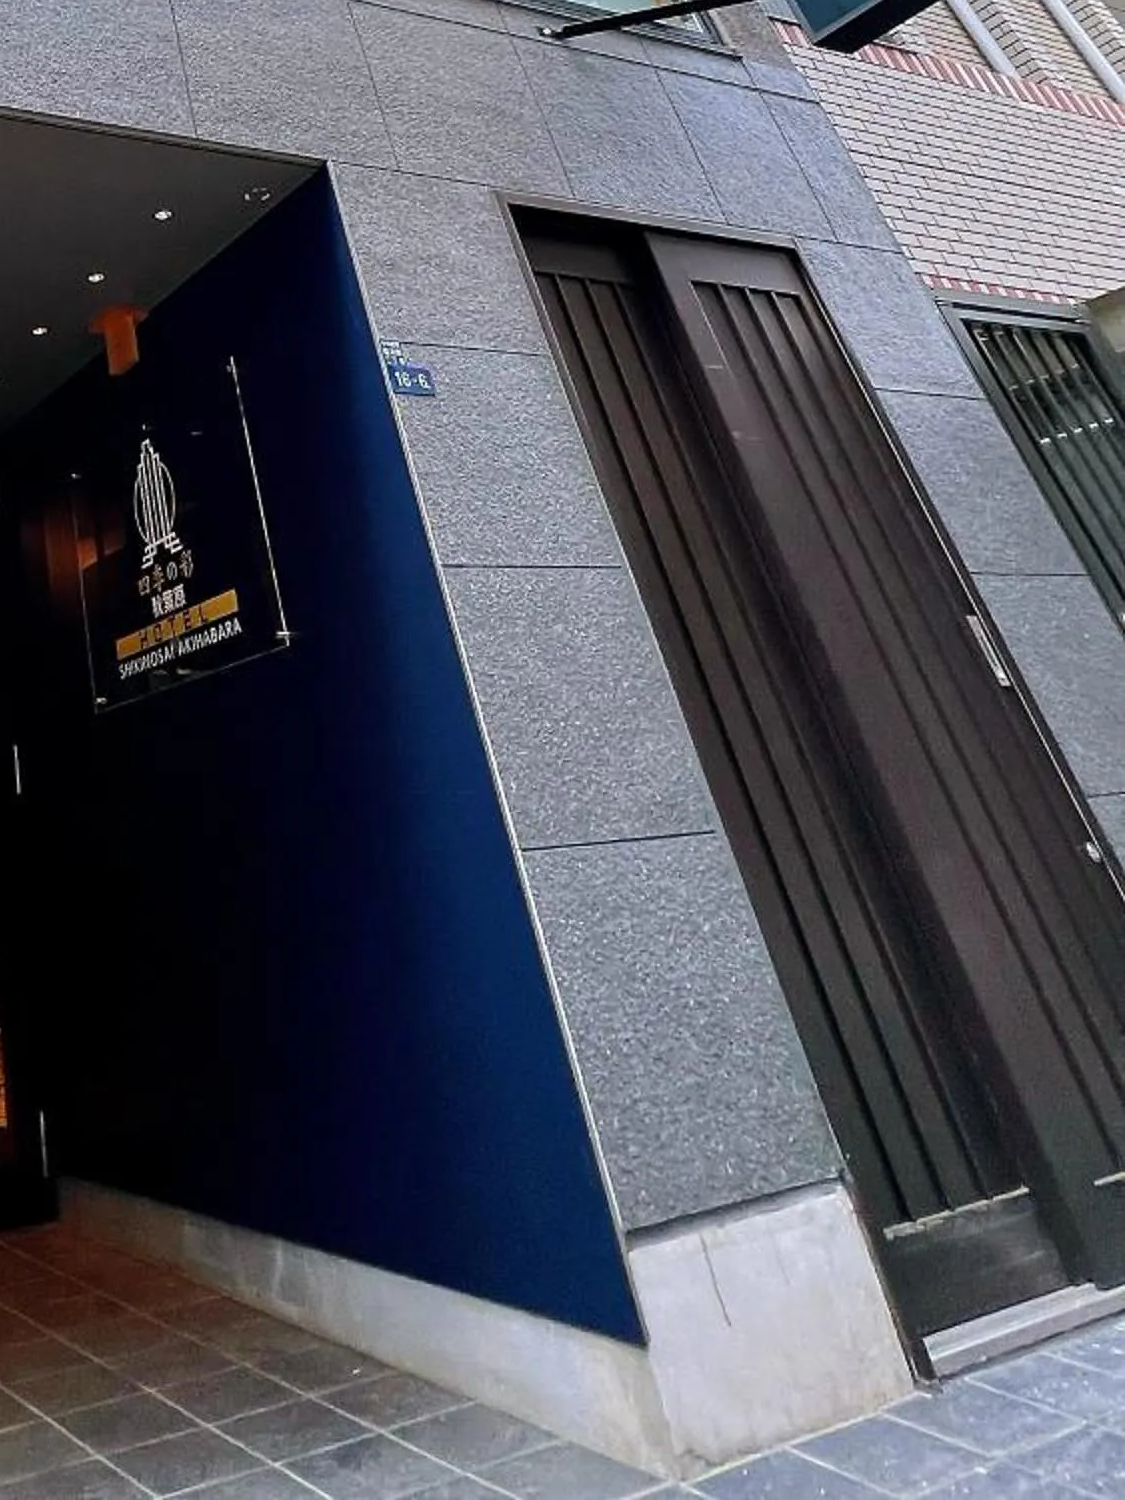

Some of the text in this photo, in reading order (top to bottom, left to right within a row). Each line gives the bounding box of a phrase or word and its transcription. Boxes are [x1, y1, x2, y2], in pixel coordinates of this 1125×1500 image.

[118, 617, 243, 680] SHIKINOSAI AKIHABARA
[139, 605, 207, 648] HOTEL
